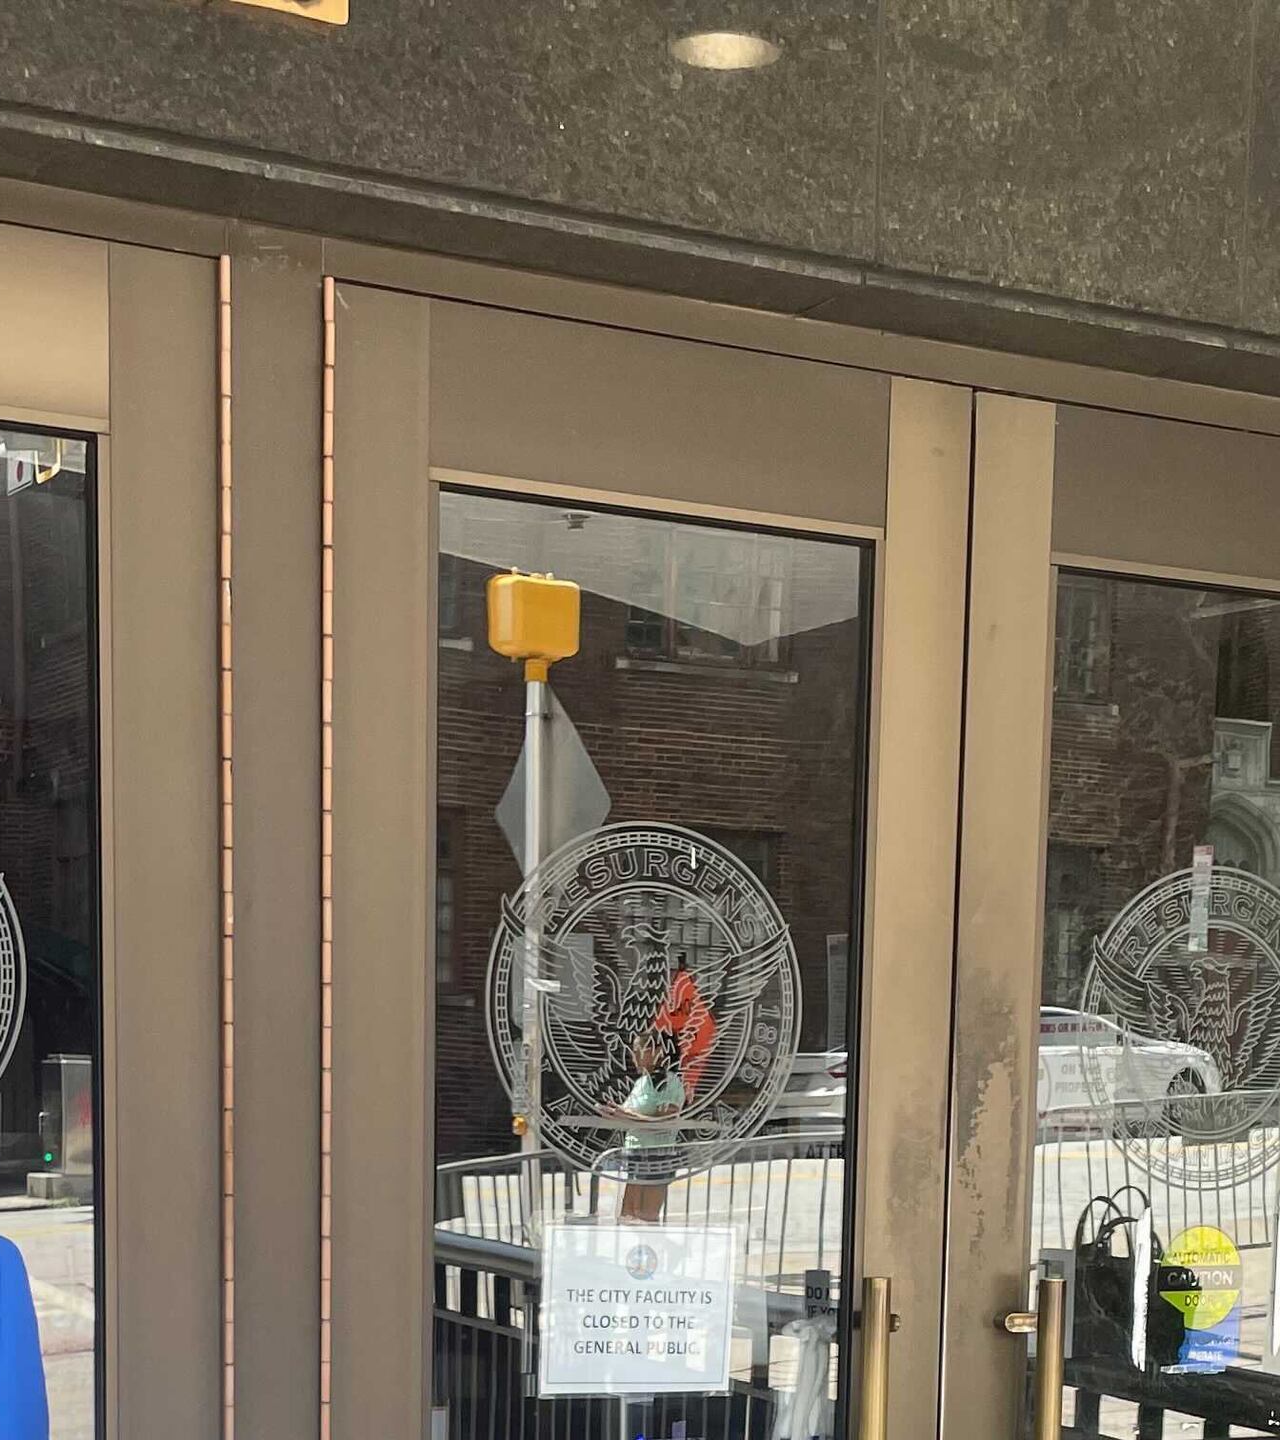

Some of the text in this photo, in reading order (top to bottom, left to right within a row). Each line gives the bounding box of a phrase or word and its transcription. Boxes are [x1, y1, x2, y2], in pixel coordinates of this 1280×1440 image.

[538, 849, 764, 946] RESURGENS
[739, 1004, 780, 1088] 1865
[1172, 1251, 1232, 1265] AUTOMATIC
[1167, 1270, 1234, 1286] CAUTION
[567, 1289, 712, 1304] THE CITY FACILITY IS
[583, 1315, 695, 1329] CLOSED TO THE
[574, 1340, 700, 1355] GENERAL PUBLIC.
